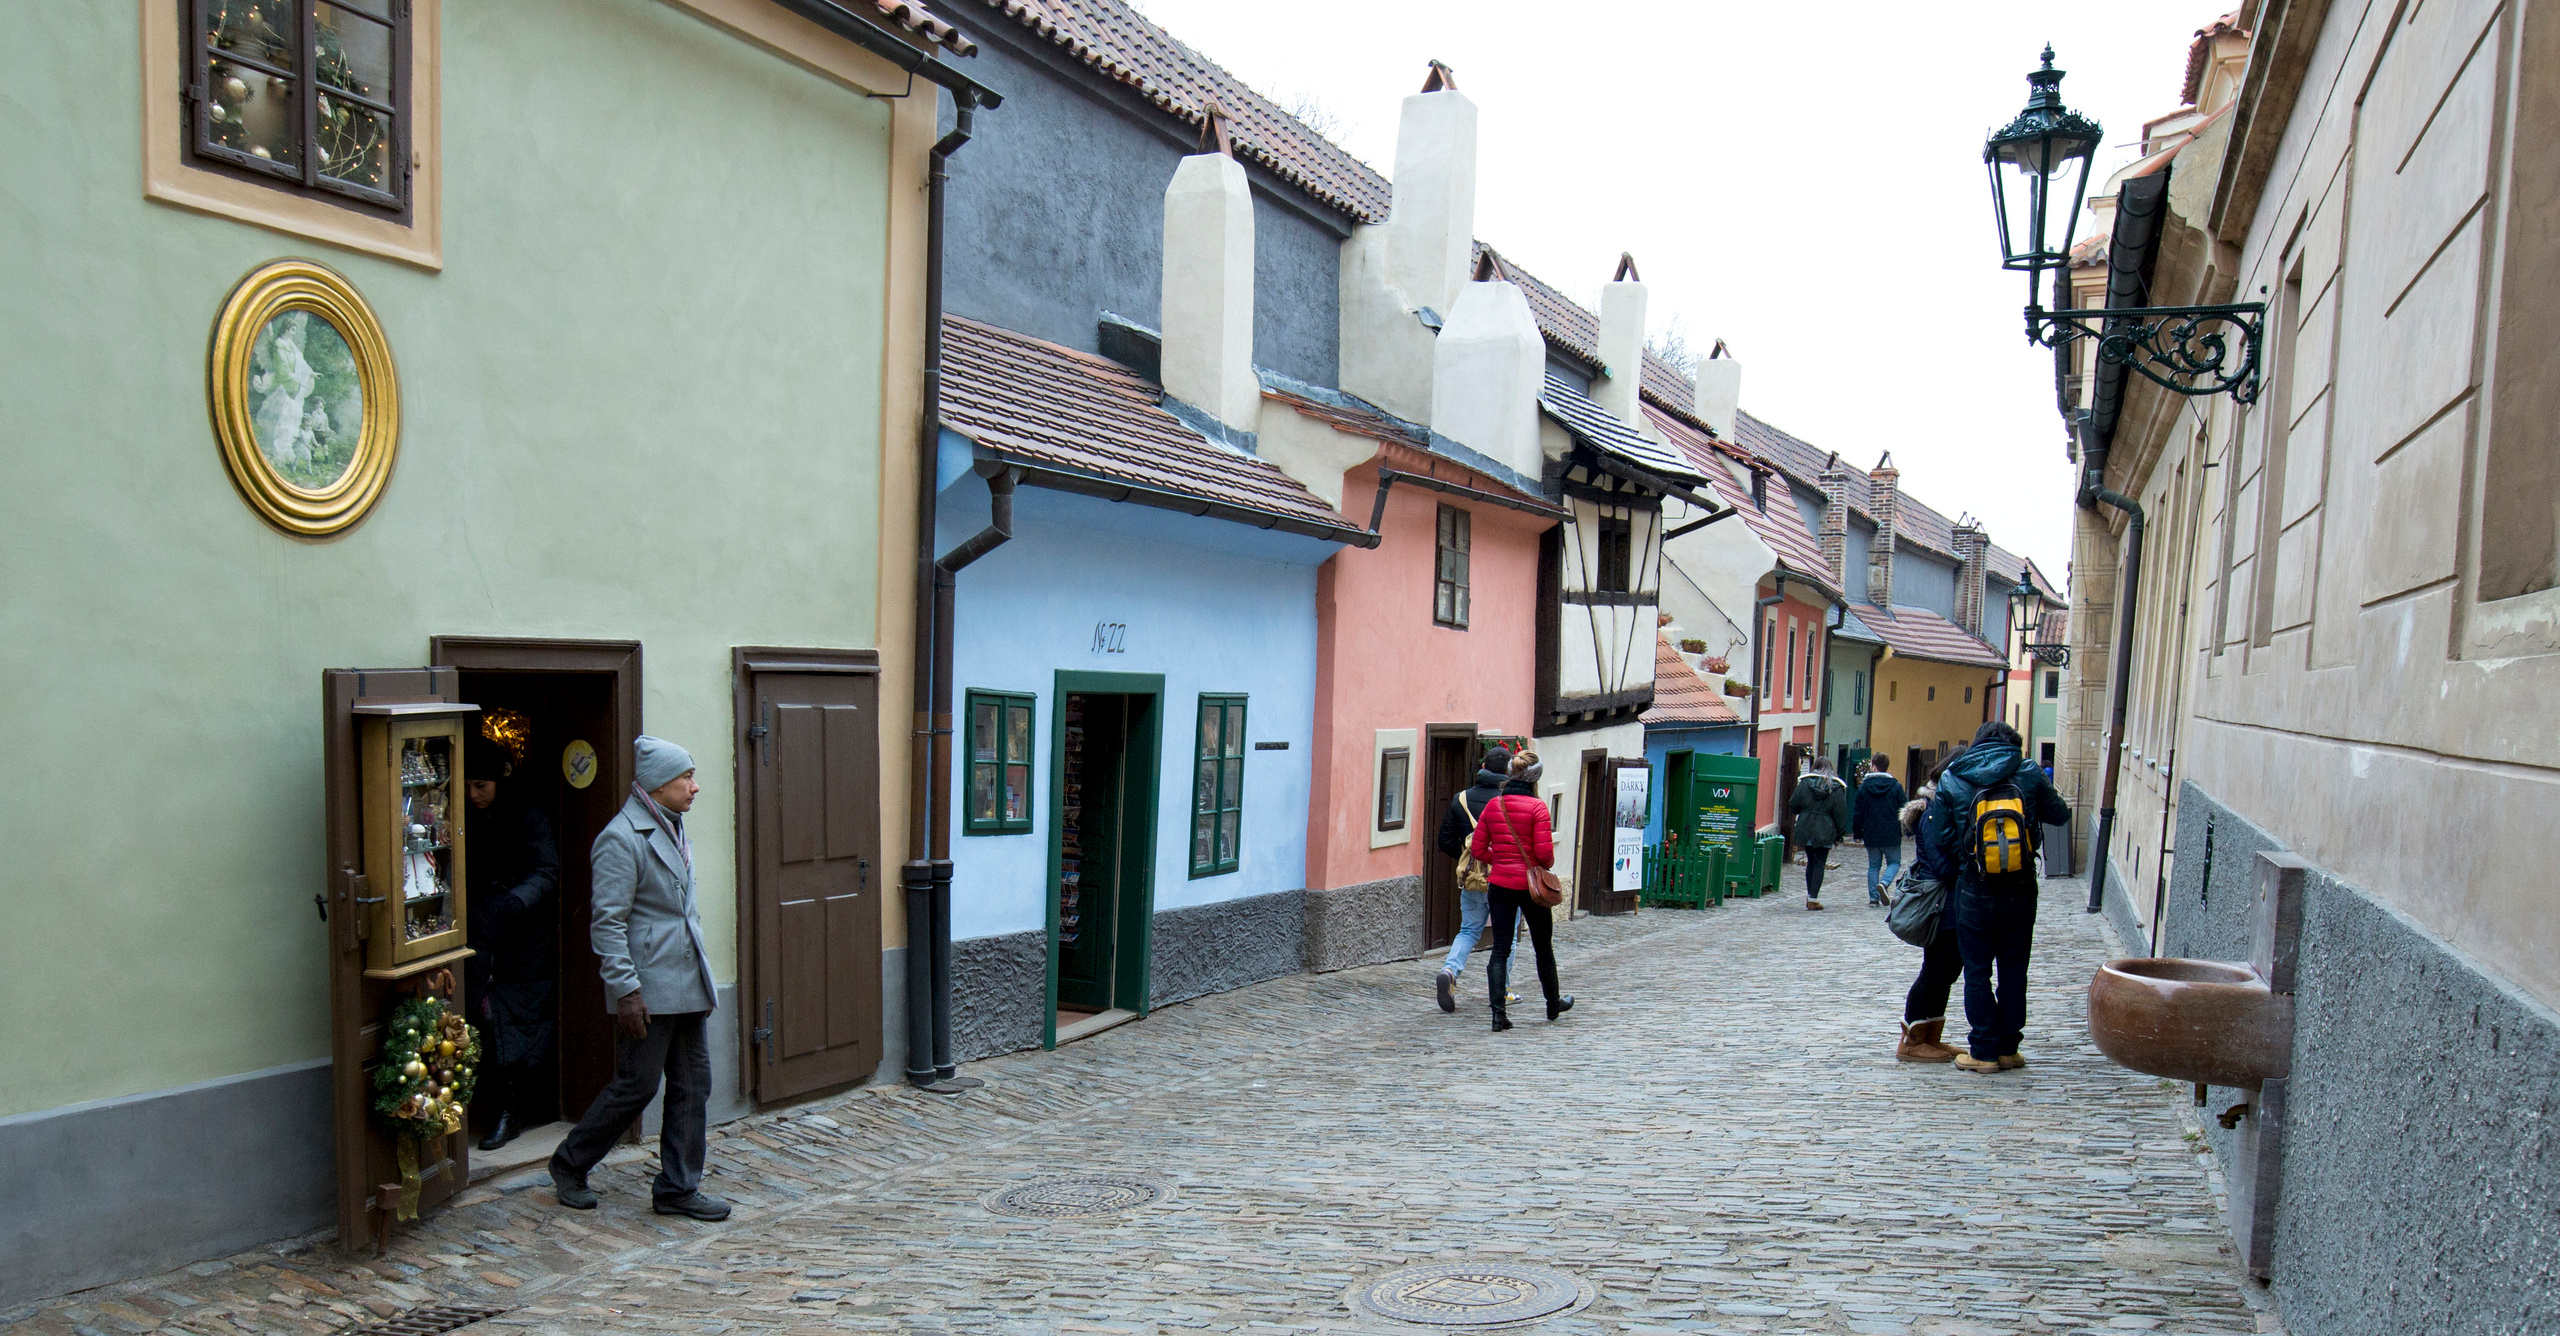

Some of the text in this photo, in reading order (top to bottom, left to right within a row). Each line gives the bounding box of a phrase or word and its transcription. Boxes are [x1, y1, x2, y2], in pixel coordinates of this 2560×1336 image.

[1620, 778, 1645, 792] DÁRKY
[1712, 787, 1731, 799] VDV
[1617, 843, 1640, 856] GIFTS
